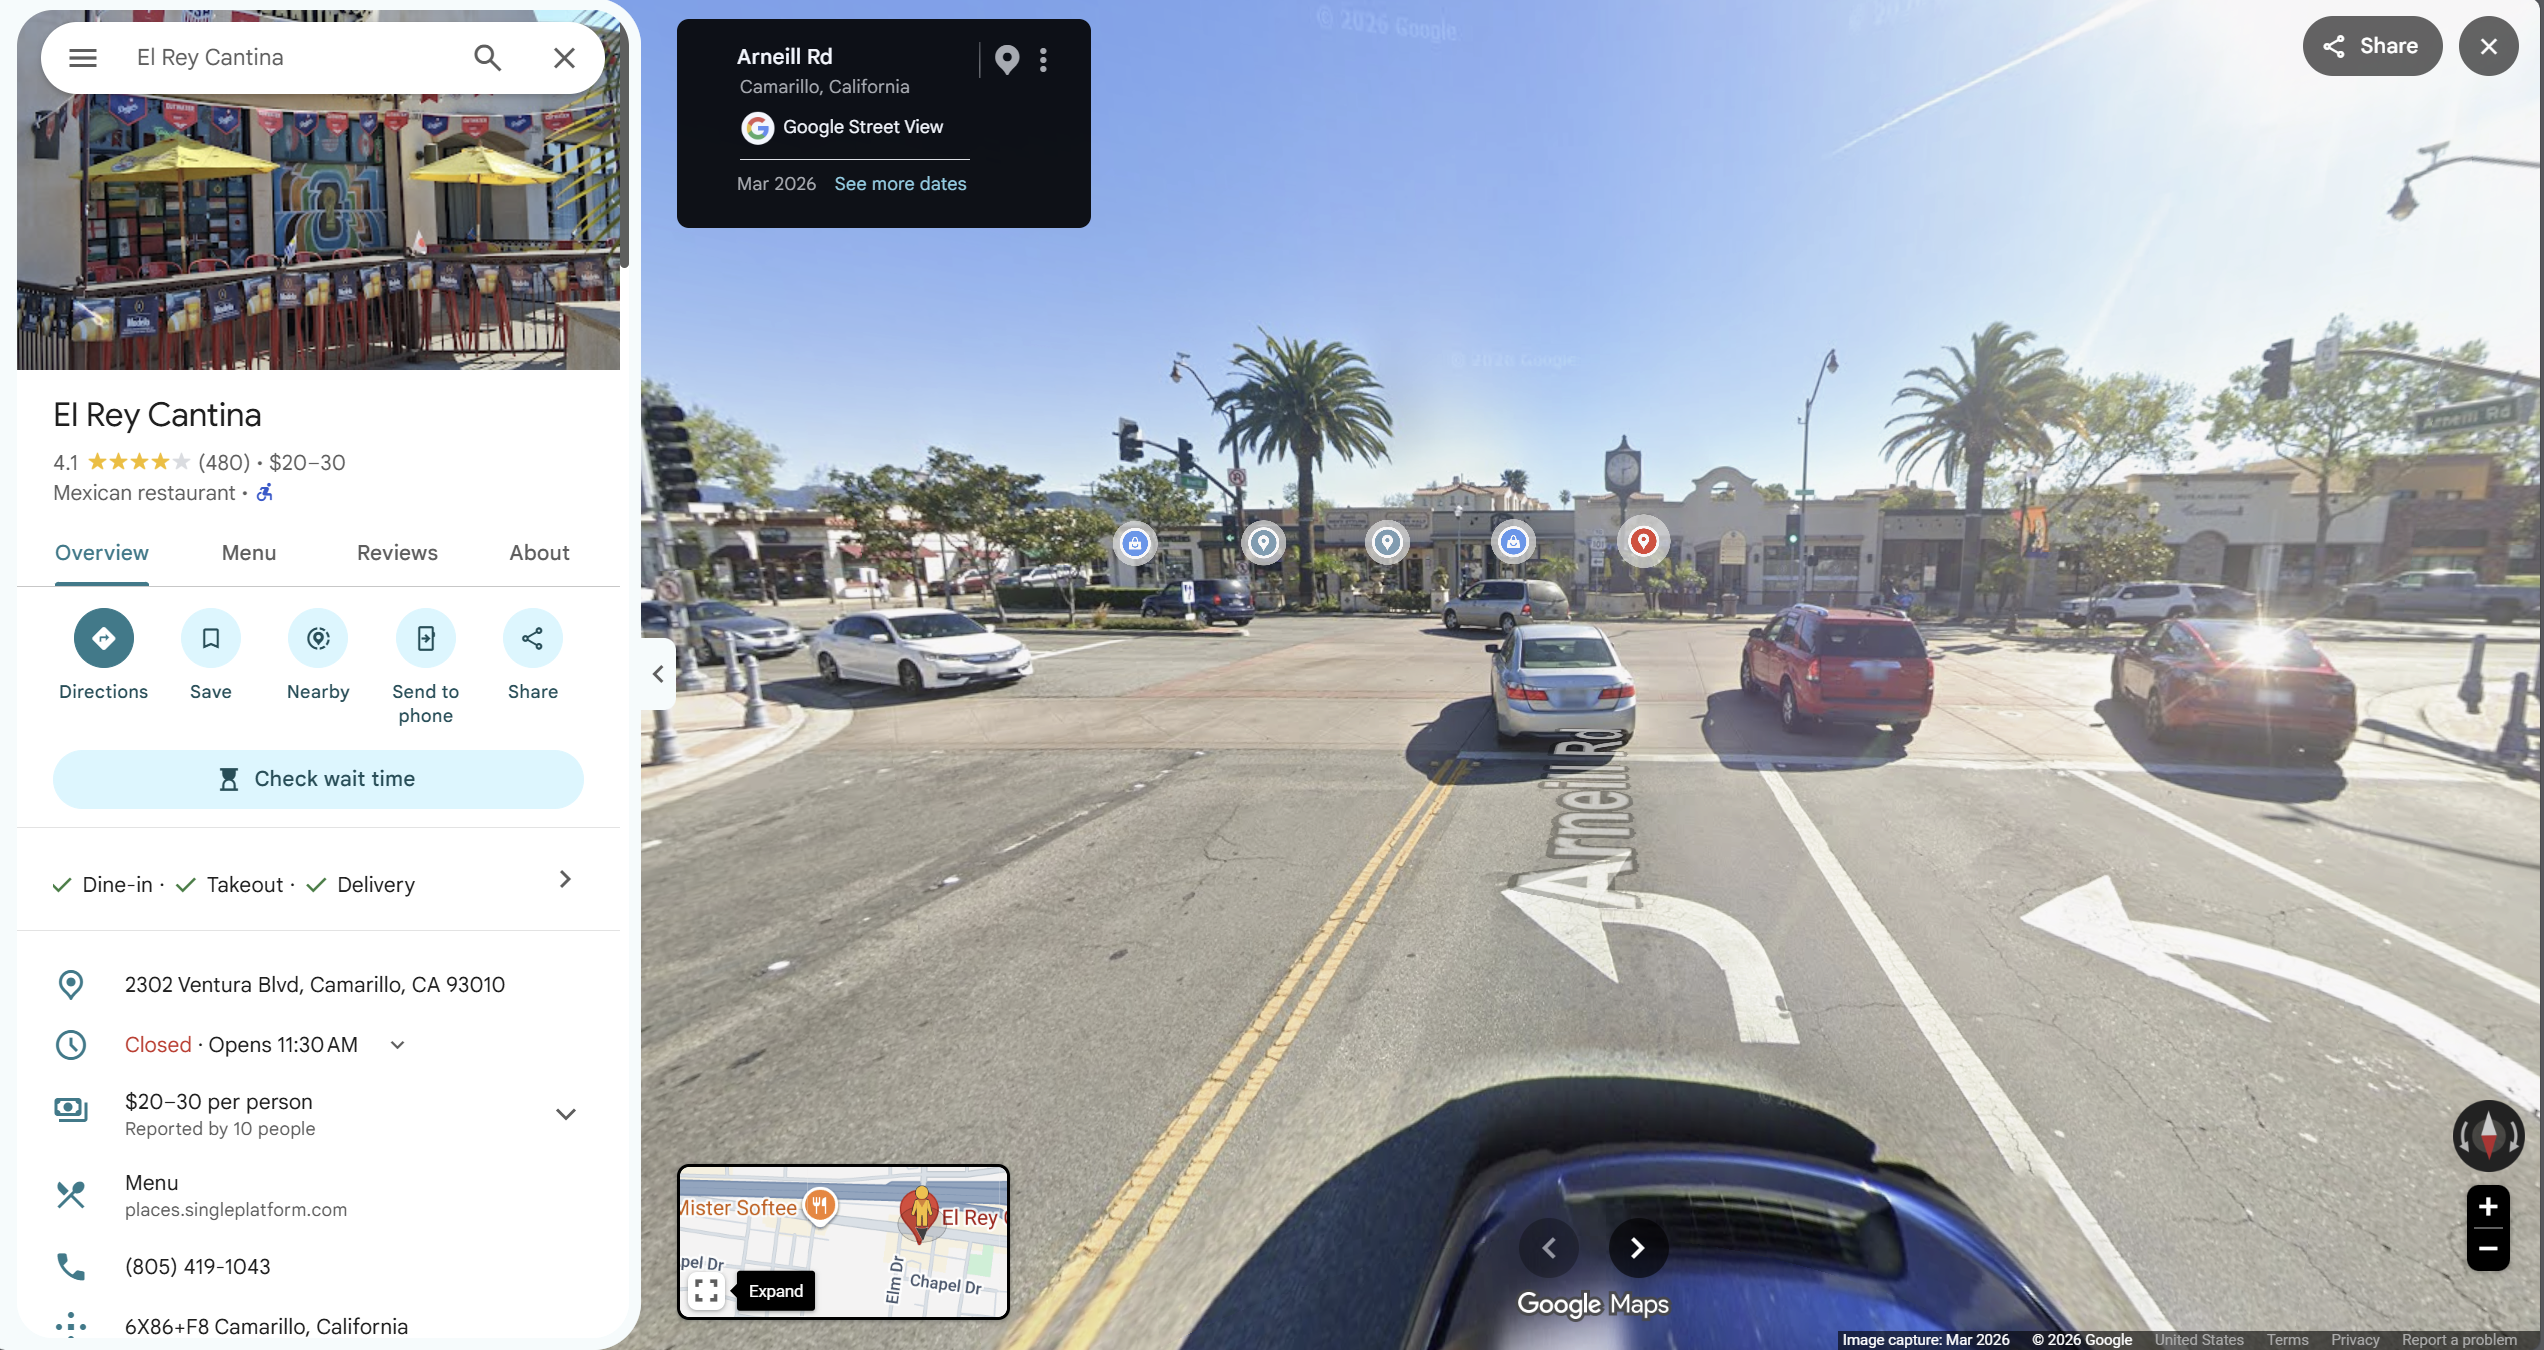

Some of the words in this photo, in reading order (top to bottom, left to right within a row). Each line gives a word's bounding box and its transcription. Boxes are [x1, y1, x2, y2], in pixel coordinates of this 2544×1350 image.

[139, 47, 154, 65] El
[163, 49, 199, 70] Rey
[206, 48, 283, 66] Cantina
[55, 402, 77, 426] El
[88, 402, 140, 433] Rey
[149, 402, 261, 427] Cantina
[2485, 405, 2511, 421] Rd
[54, 455, 78, 470] 4.1
[199, 453, 249, 473] (480)
[55, 484, 131, 501] Mexican
[139, 486, 235, 501] restaurant
[56, 543, 149, 561] Overview
[223, 545, 275, 561] Menu
[358, 543, 438, 561] Reviews
[510, 544, 570, 561] About
[60, 684, 148, 698] Directions
[191, 685, 231, 698] Save
[288, 684, 350, 702] Nearby
[393, 684, 436, 698] Send
[442, 686, 459, 698] to
[509, 684, 558, 698] Share
[399, 708, 453, 726] phone
[255, 770, 318, 787] Check
[324, 769, 365, 787] wait
[372, 769, 415, 787] time
[84, 876, 152, 893] Dine-in
[207, 876, 283, 893] Takeout
[339, 876, 415, 897] Delivery
[126, 976, 172, 993] 2302
[178, 977, 251, 993] Ventura
[259, 976, 303, 995] Blvd,
[311, 976, 405, 995] Camarillo,
[412, 976, 440, 993] CA
[447, 976, 505, 993] 93010
[126, 1036, 191, 1053] Closed
[209, 1036, 271, 1057] Opens
[209, 1097, 240, 1114] per
[247, 1097, 312, 1114] person
[126, 1121, 202, 1139] Reported
[209, 1121, 228, 1139] by
[234, 1122, 252, 1135] 10
[259, 1121, 315, 1139] people
[126, 1175, 178, 1191] Menu
[126, 1202, 346, 1220] places.singleplatform.com
[126, 1257, 176, 1277] (805)
[184, 1258, 270, 1275] 419-1043
[126, 1318, 209, 1335] 6X86+F8
[215, 1318, 310, 1337] Camarillo,
[317, 1317, 408, 1335] California
